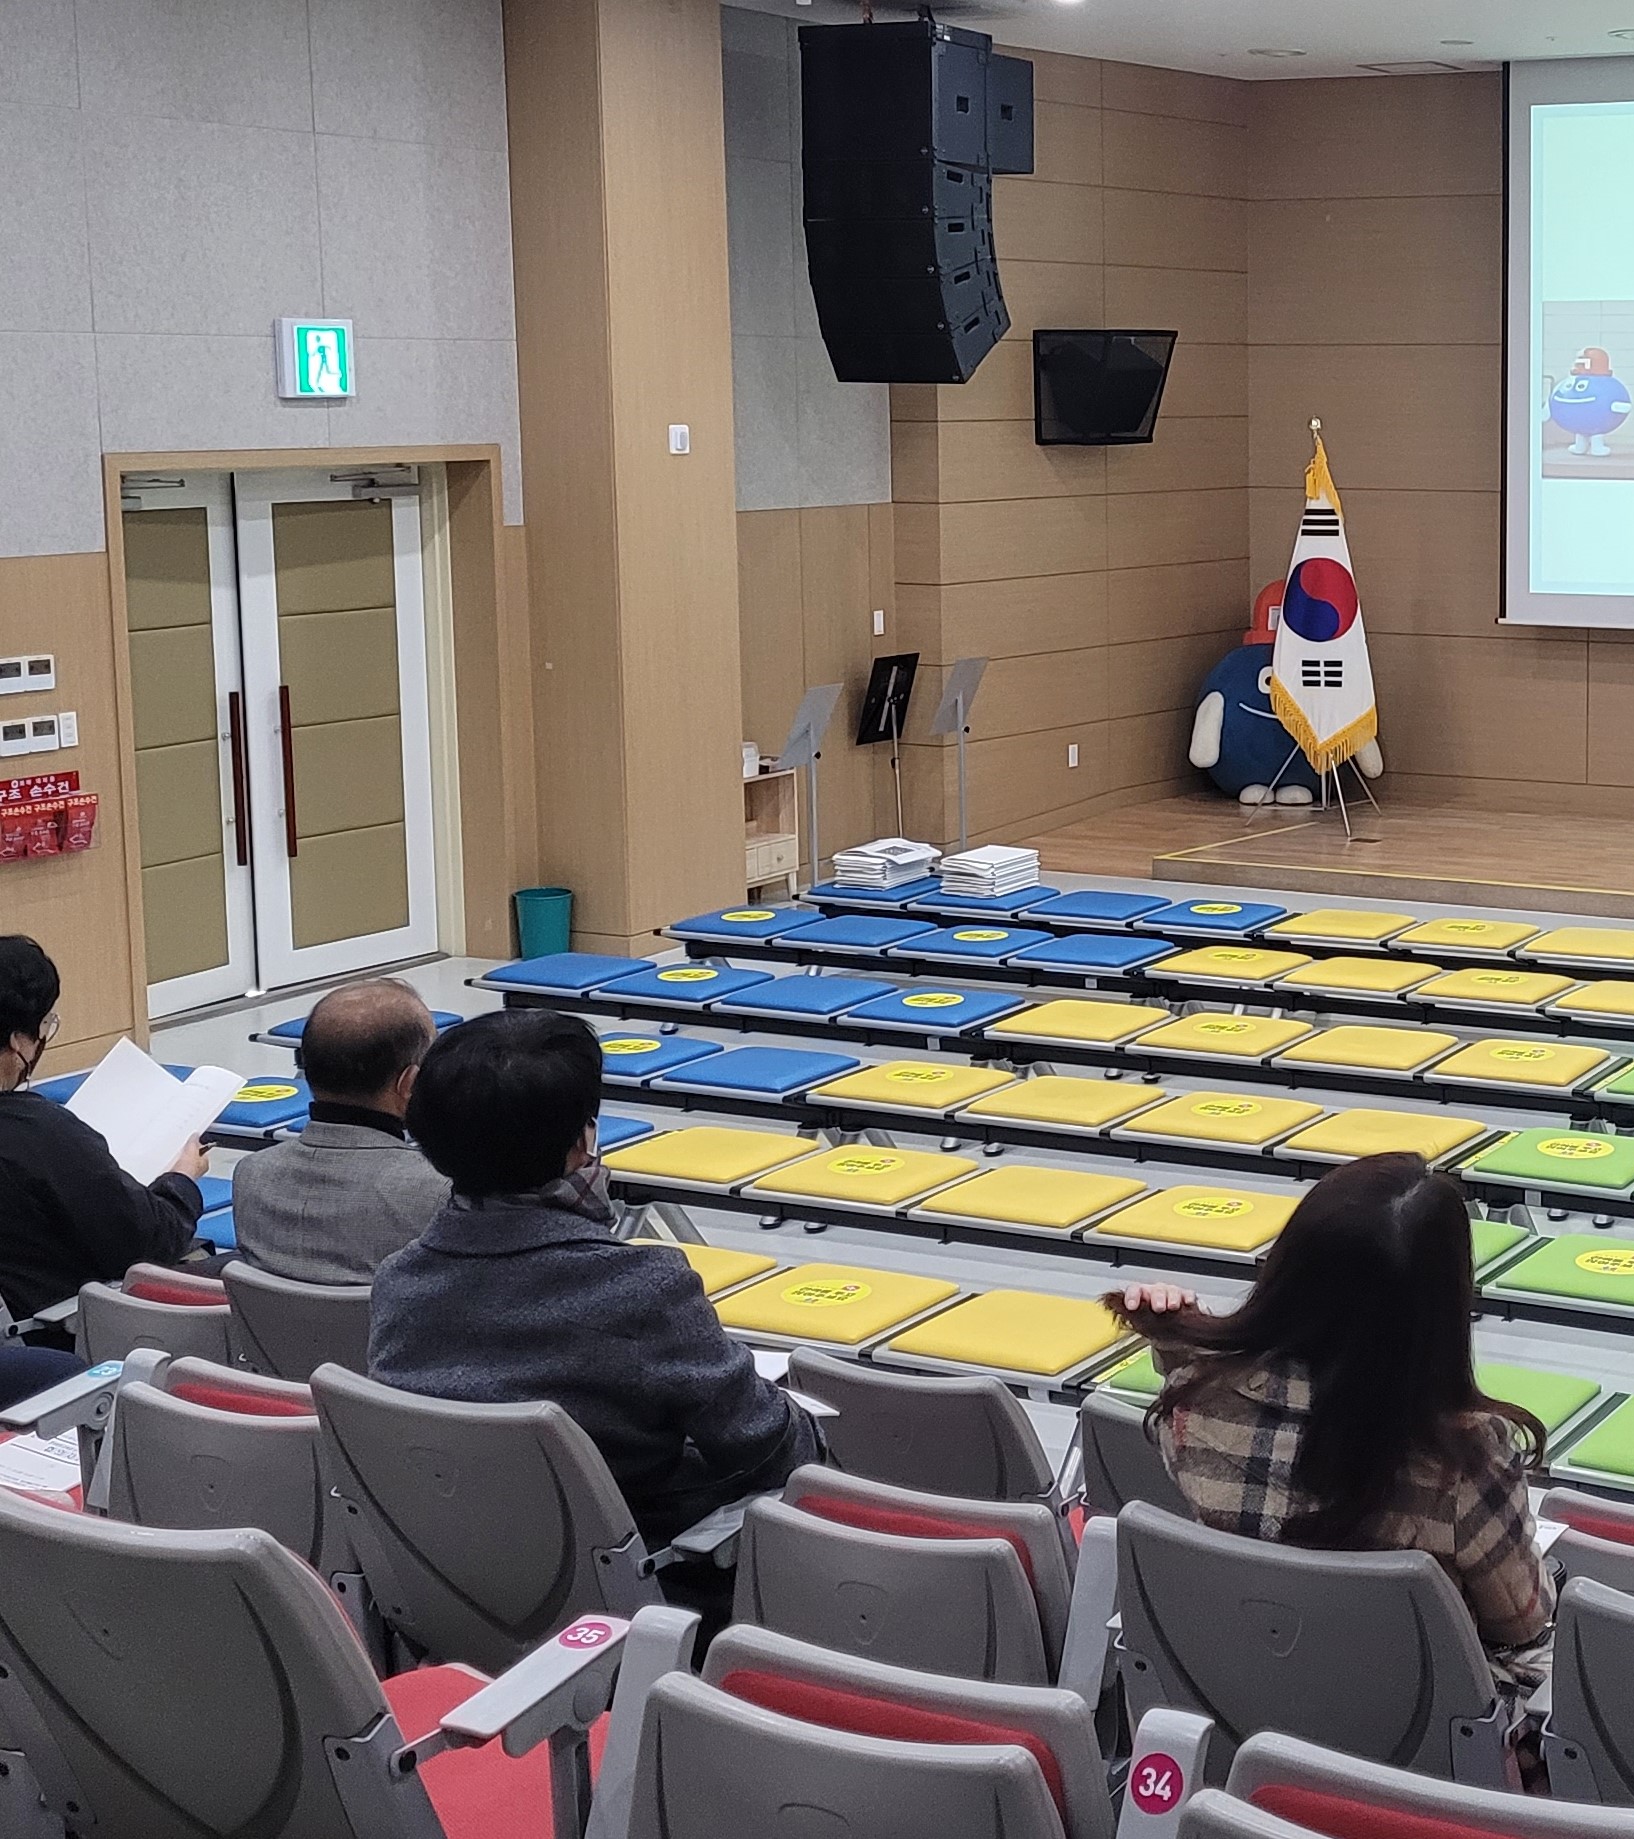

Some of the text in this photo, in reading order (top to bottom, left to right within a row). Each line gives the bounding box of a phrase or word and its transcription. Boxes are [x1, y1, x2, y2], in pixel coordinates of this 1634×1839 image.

[30, 780, 69, 798] 손수건
[566, 1627, 606, 1644] 35
[1138, 1767, 1172, 1801] 34
